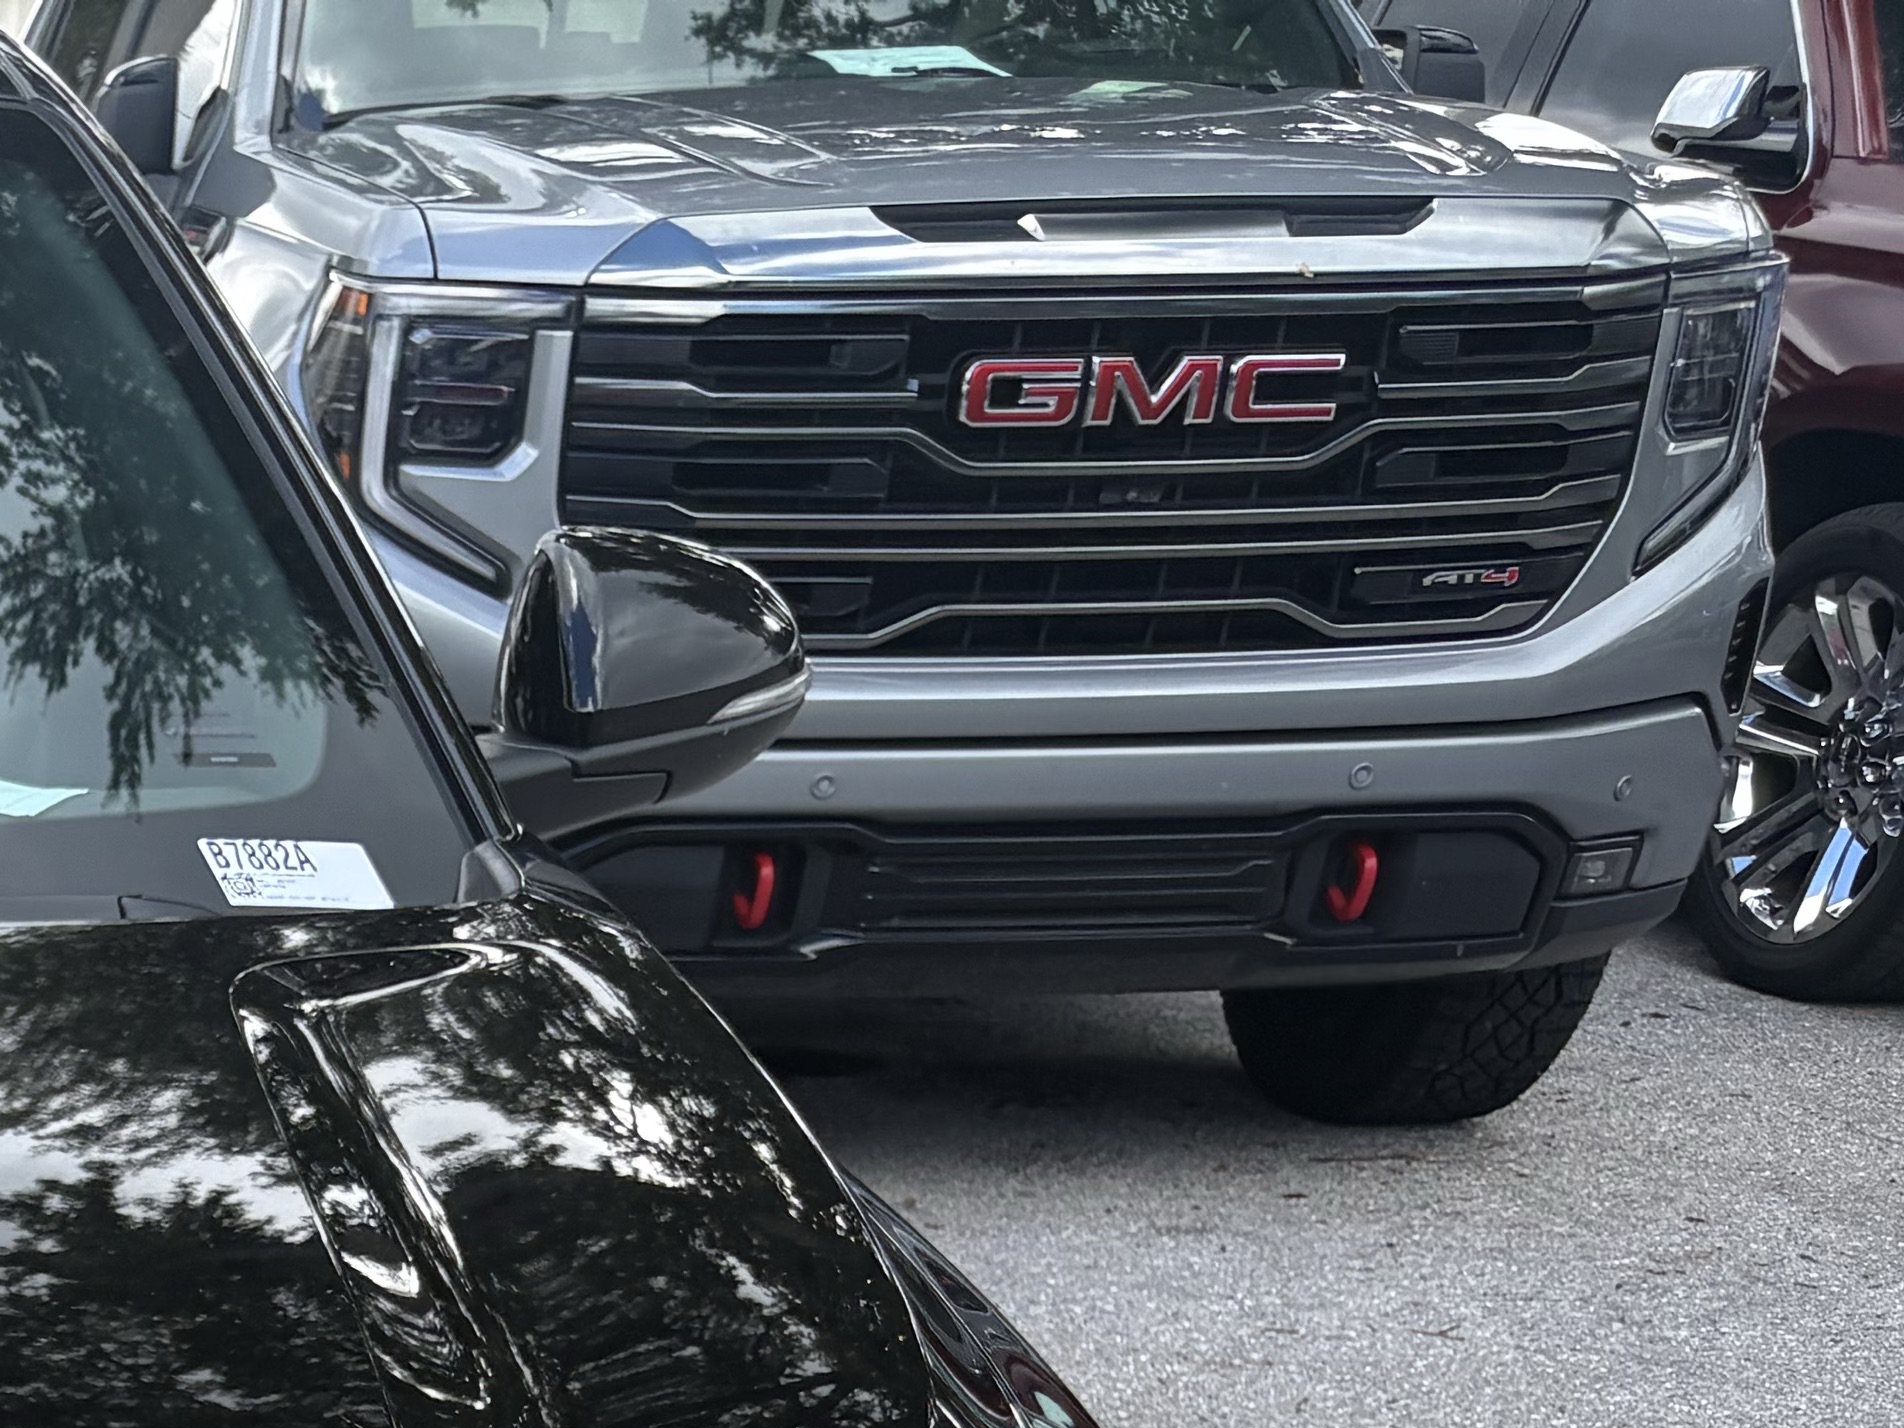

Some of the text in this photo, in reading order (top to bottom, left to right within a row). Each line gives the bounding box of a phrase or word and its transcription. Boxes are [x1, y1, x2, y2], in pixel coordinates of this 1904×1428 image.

[959, 353, 1346, 428] GMC
[1422, 566, 1520, 587] AT4
[206, 840, 318, 872] B7882A
